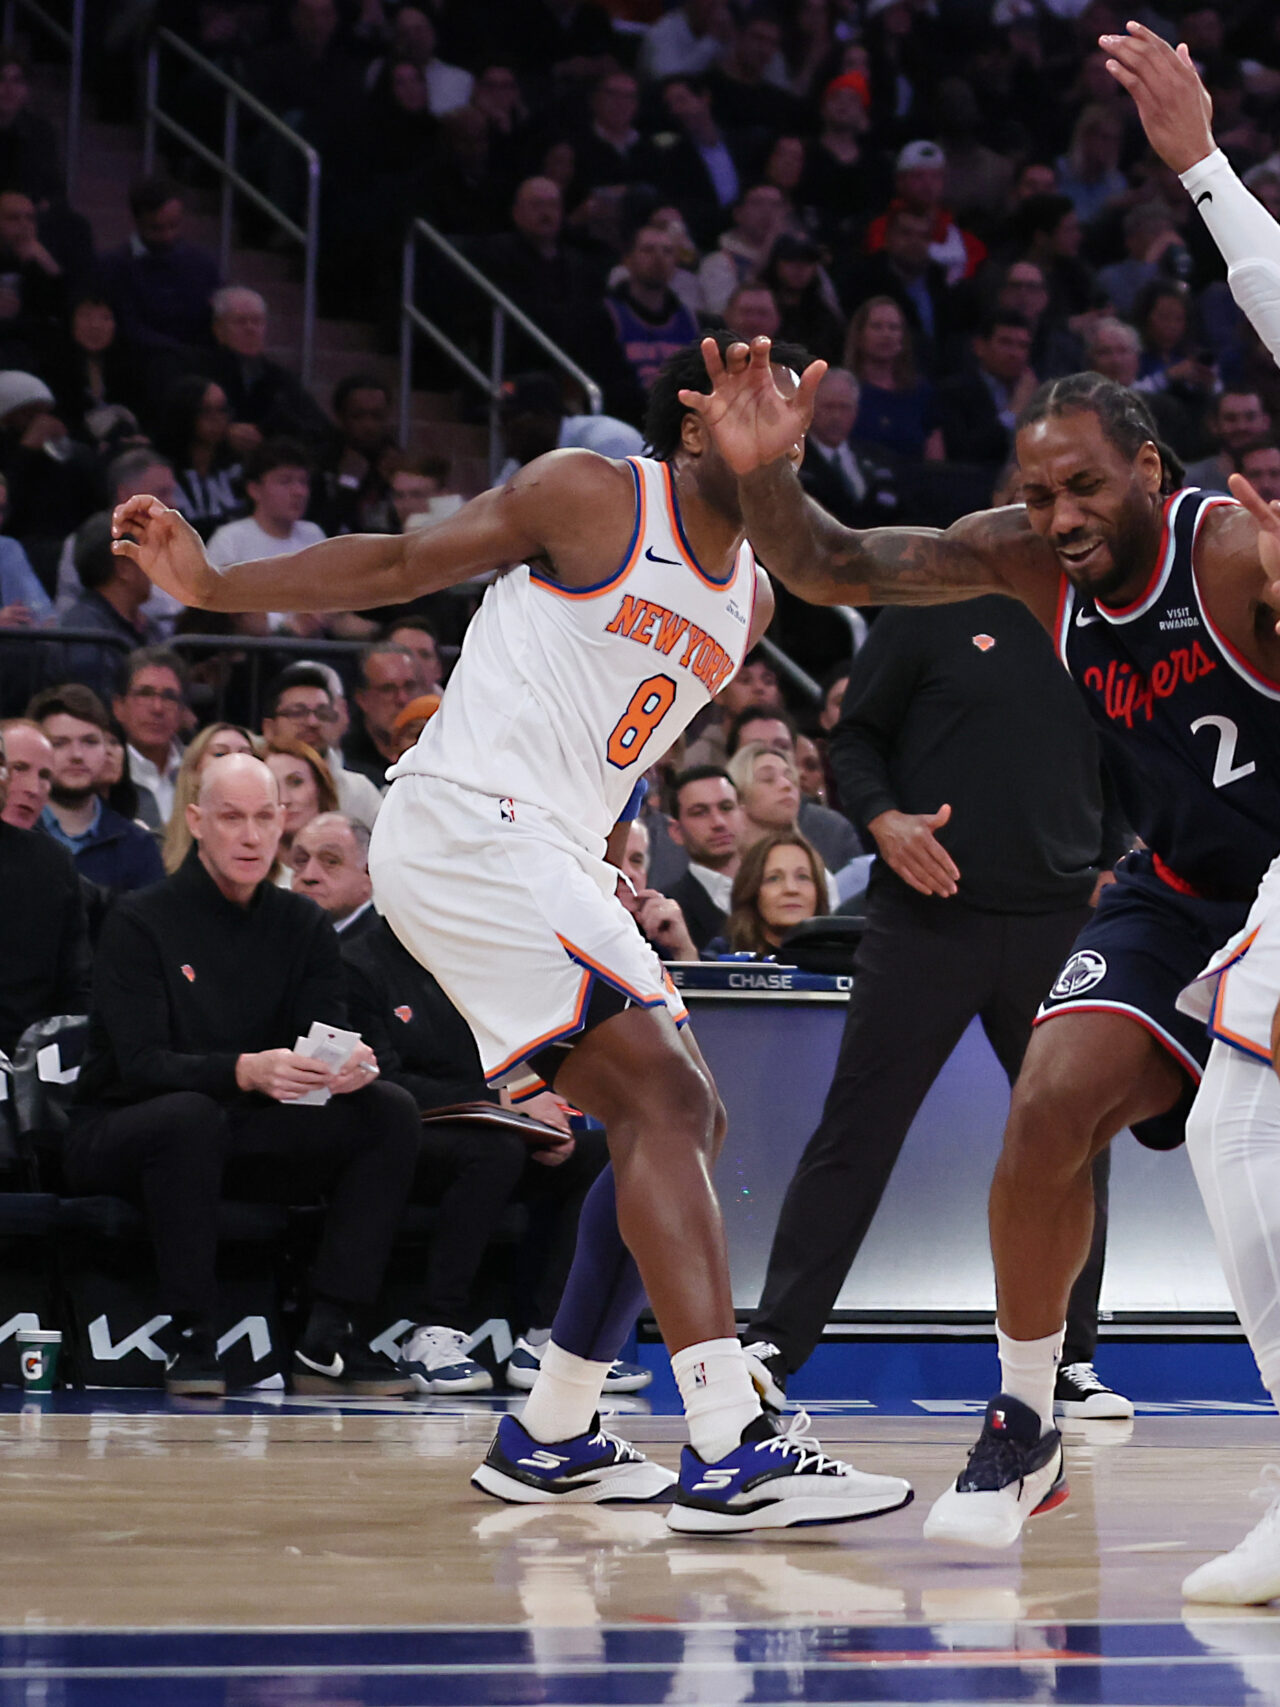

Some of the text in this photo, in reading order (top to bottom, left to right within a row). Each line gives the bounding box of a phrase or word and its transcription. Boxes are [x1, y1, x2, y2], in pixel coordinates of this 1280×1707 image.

[1159, 616, 1200, 631] RWANDA
[1166, 607, 1190, 619] VISIT
[605, 594, 735, 698] NEW YORK
[606, 673, 677, 770] 8
[1190, 714, 1256, 789] 2
[729, 973, 793, 990] CHASE
[88, 1313, 272, 1362] KA
